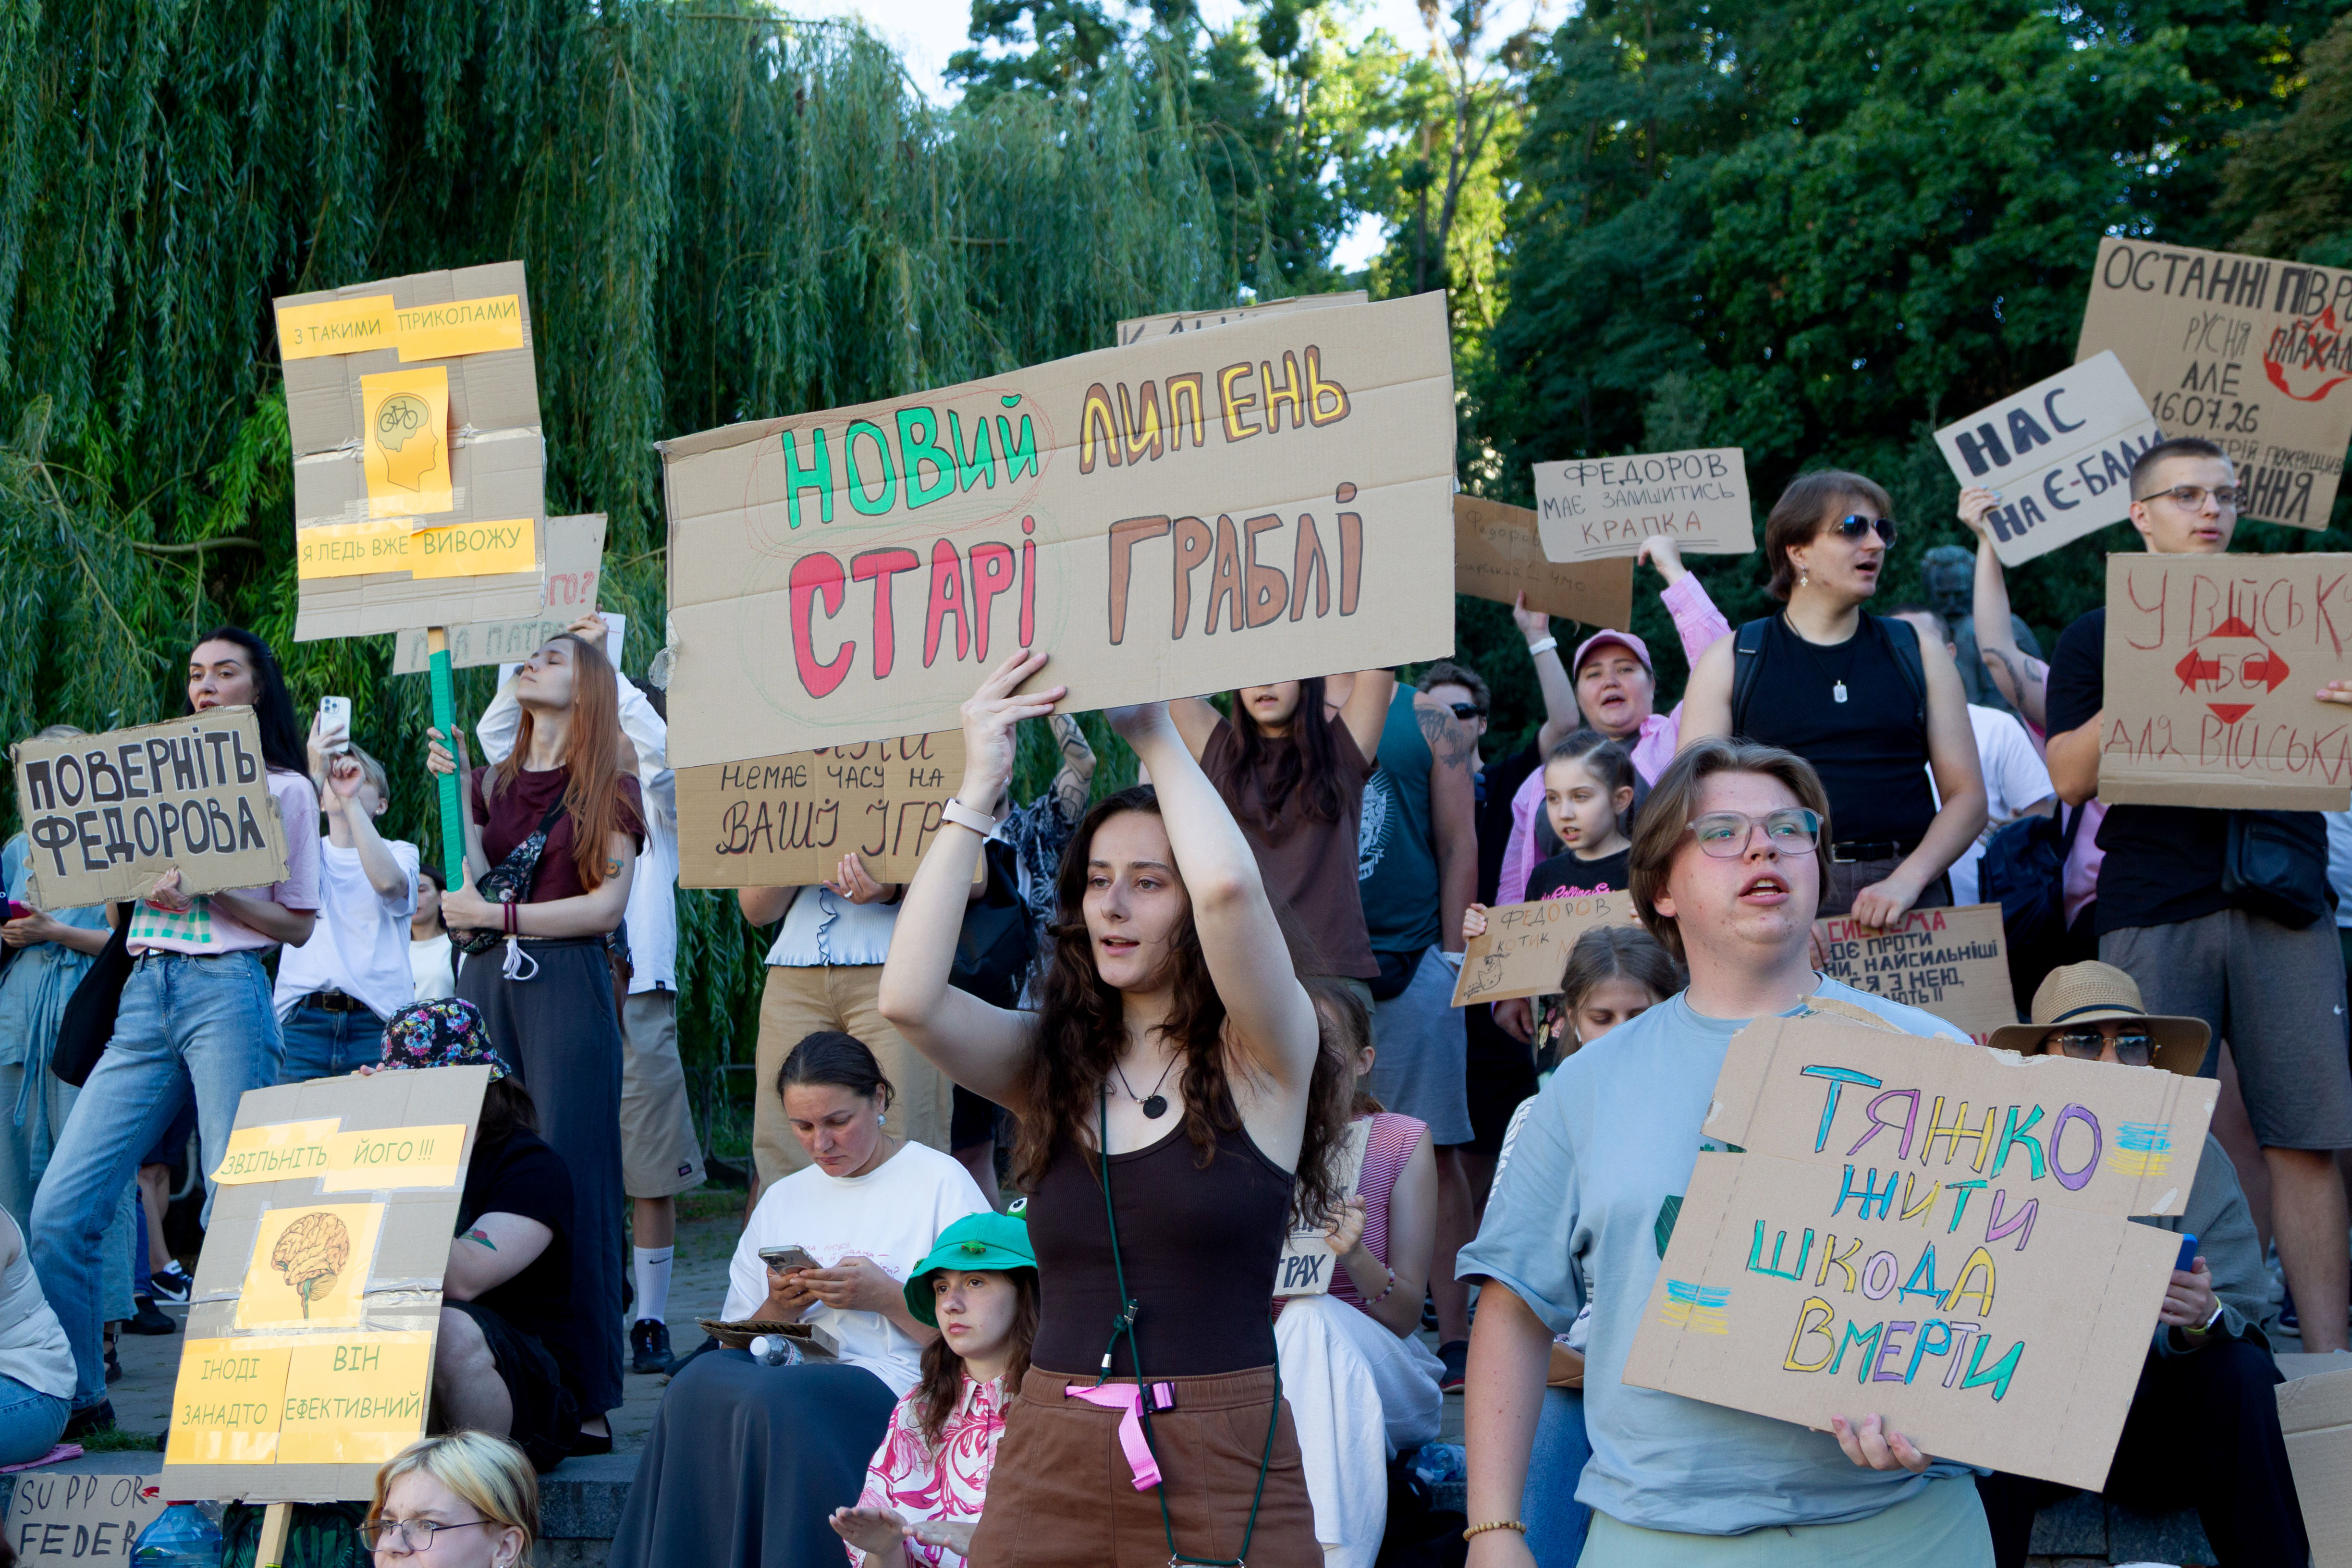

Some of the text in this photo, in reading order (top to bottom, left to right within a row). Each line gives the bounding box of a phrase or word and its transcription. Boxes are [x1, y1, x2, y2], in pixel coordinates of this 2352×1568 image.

[2103, 245, 2270, 309] ОСТАННІ
[294, 301, 517, 344] З ТАКИМИ ПРИКОЛАМИ
[2183, 311, 2252, 358] РУСНЯ
[2180, 361, 2242, 397] АЛЕ
[1955, 388, 2086, 477] НАС
[2152, 393, 2260, 434] 16.07.26
[781, 344, 1351, 531] НОВИЙ ЛИПЕНЬ
[1564, 454, 1728, 487] ФЕДОРОВ
[1543, 482, 1735, 519] МАЄ ЗАЛИШИТИСЬ
[2234, 463, 2315, 523] АННЯ
[303, 527, 521, 563] Я ЛЕДЬ ВЖЕ ВИВОЖУ
[1582, 510, 1702, 544] КРАПКА
[546, 571, 595, 606] ГО?
[789, 481, 1363, 698] СТАРІ ГРАБЛІ
[2124, 568, 2168, 650] У
[2179, 652, 2270, 696] АБО
[2104, 714, 2188, 765] ДЛЯ
[25, 726, 257, 811] ПОВЕРНІТЬ
[827, 765, 884, 789] ЧАСУ
[909, 767, 944, 788] НА
[31, 796, 266, 877] ФЕДОРОВА
[861, 799, 943, 857] ІГР
[1501, 898, 1611, 930] ФЕДОРОВ
[1497, 932, 1549, 953] КОТИК
[1825, 939, 1998, 978] НИ, НАЙСИЛЬНІШІ
[1868, 932, 1933, 955] ПРОТИ
[1888, 973, 1903, 991] З
[1910, 967, 1964, 989] НЕЮ,
[1801, 1065, 2103, 1191] ТЯЖКО
[220, 1145, 327, 1176] ЗВІЛЬНІТЬ
[1831, 1164, 2039, 1251] ЖИТИ
[1279, 1254, 1327, 1288] РАХ
[1746, 1219, 1997, 1318] ШКОДА
[201, 1345, 380, 1381] ІНОДІ ВІН
[1783, 1296, 2025, 1404] ВМЕРТИ
[182, 1391, 420, 1428] ЗАНАДТО ЕФЕКТИВНИЙ
[20, 1475, 148, 1515] SUPPOR
[19, 1520, 136, 1558] FEDER
